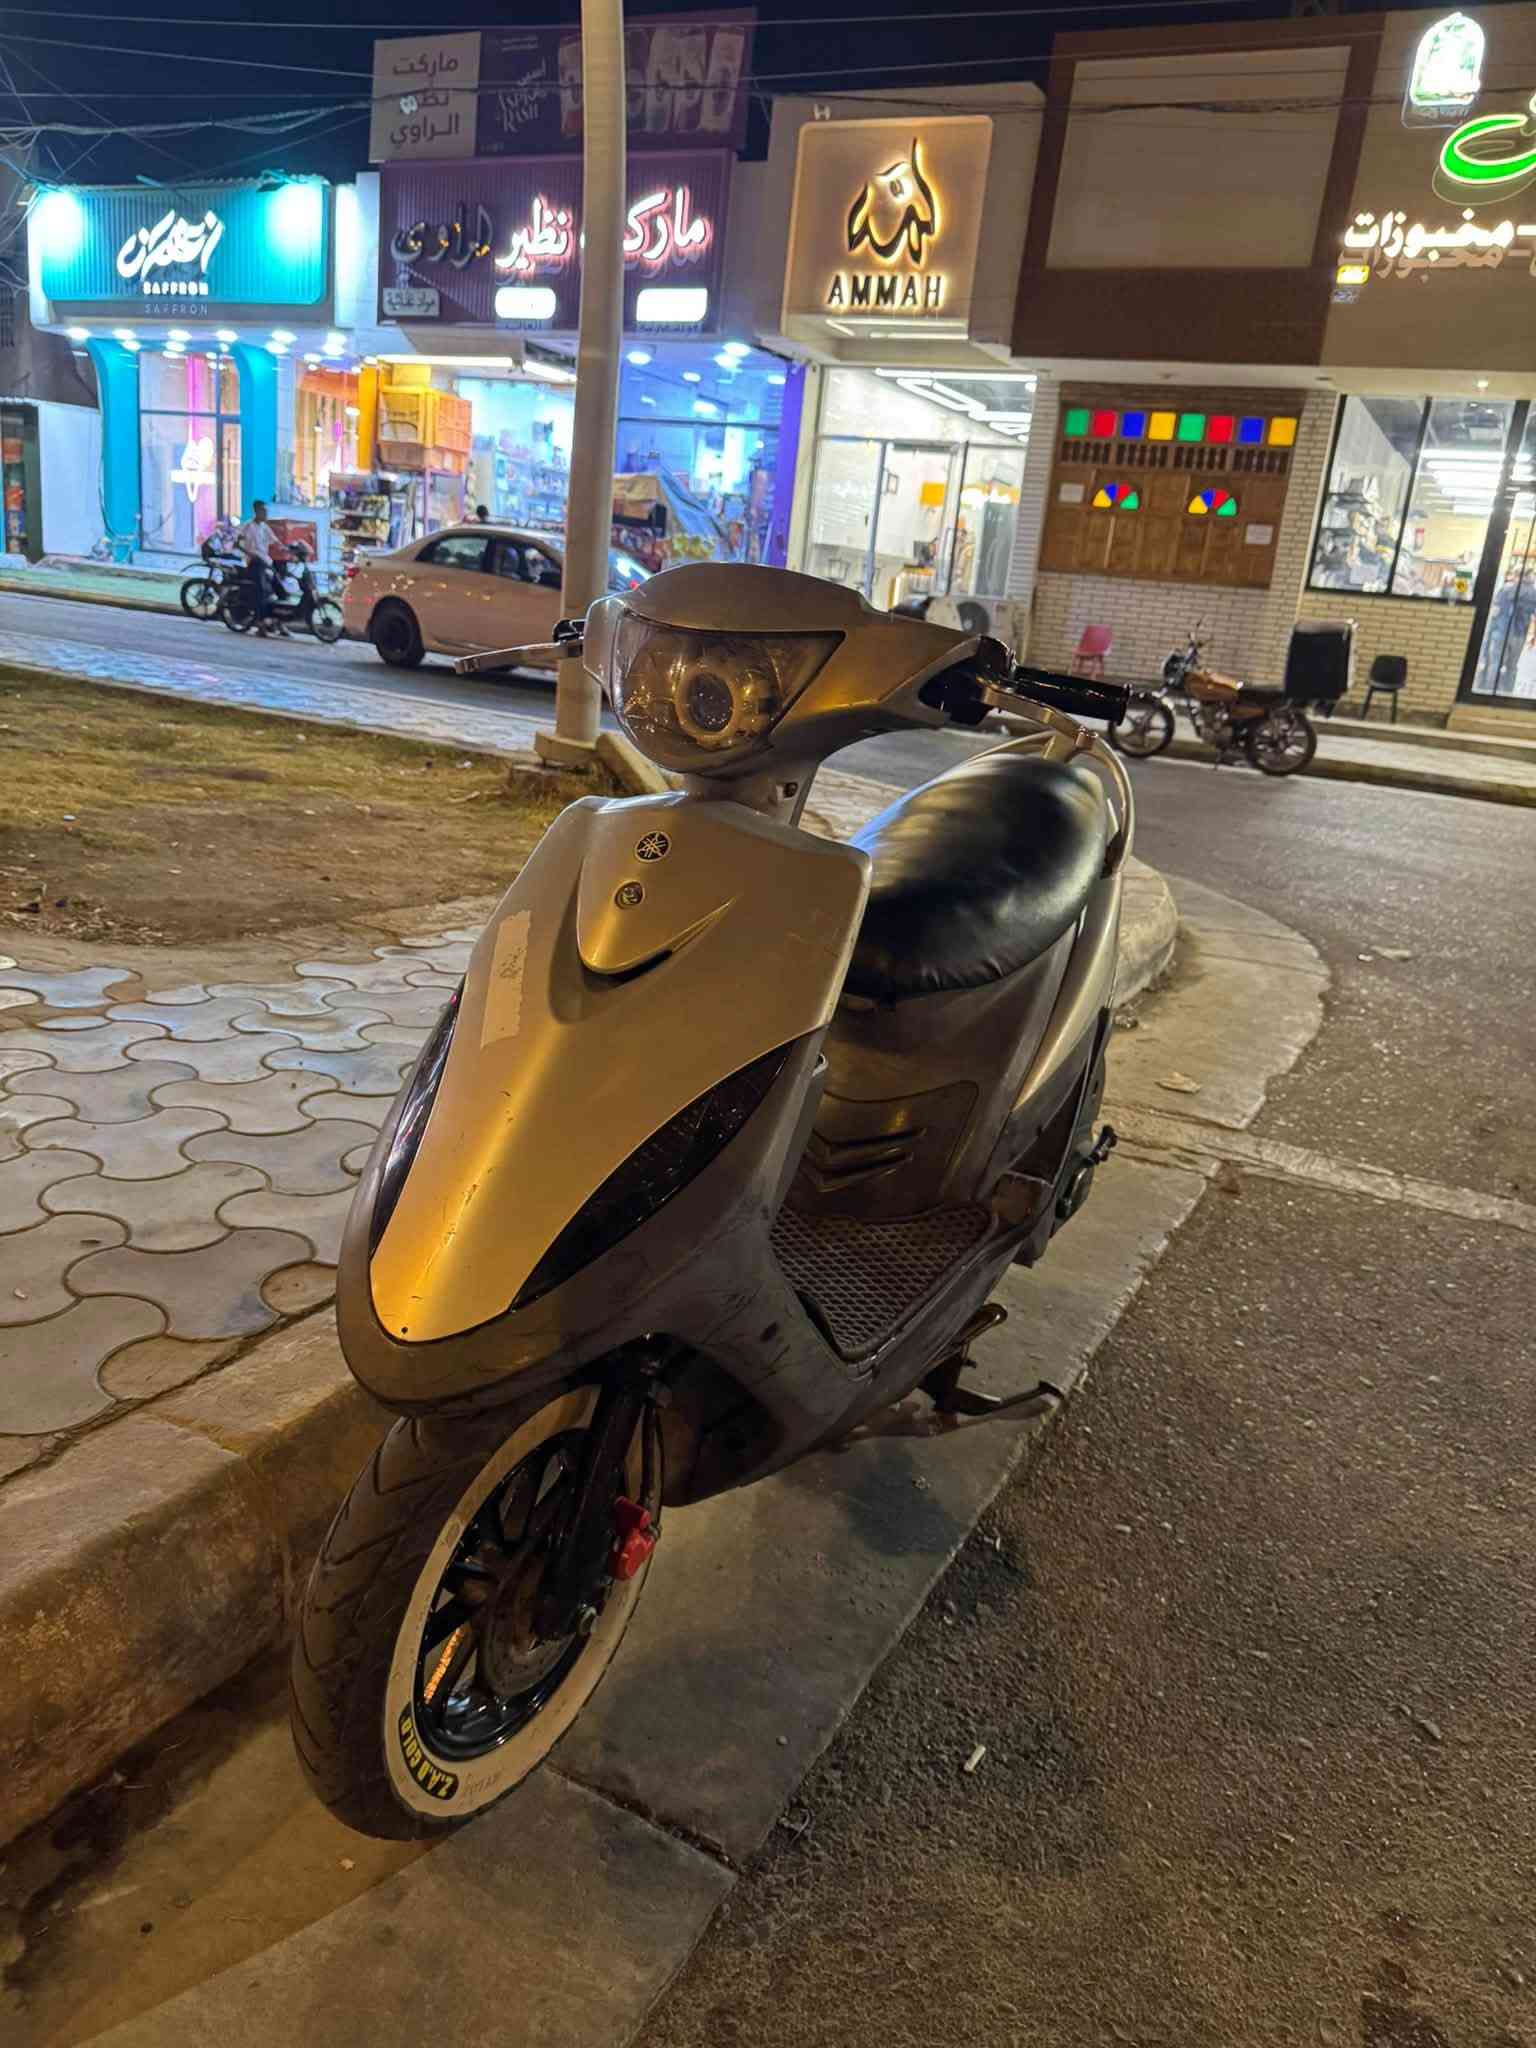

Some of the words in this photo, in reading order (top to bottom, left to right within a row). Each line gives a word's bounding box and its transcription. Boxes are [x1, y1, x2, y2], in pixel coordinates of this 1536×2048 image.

[392, 51, 459, 77] ماركت
[389, 112, 460, 149] الراوي
[494, 196, 572, 270] نظير
[1343, 207, 1515, 262] مخبوزات
[143, 281, 209, 295] SAFFRON
[827, 273, 942, 309] AMMAH
